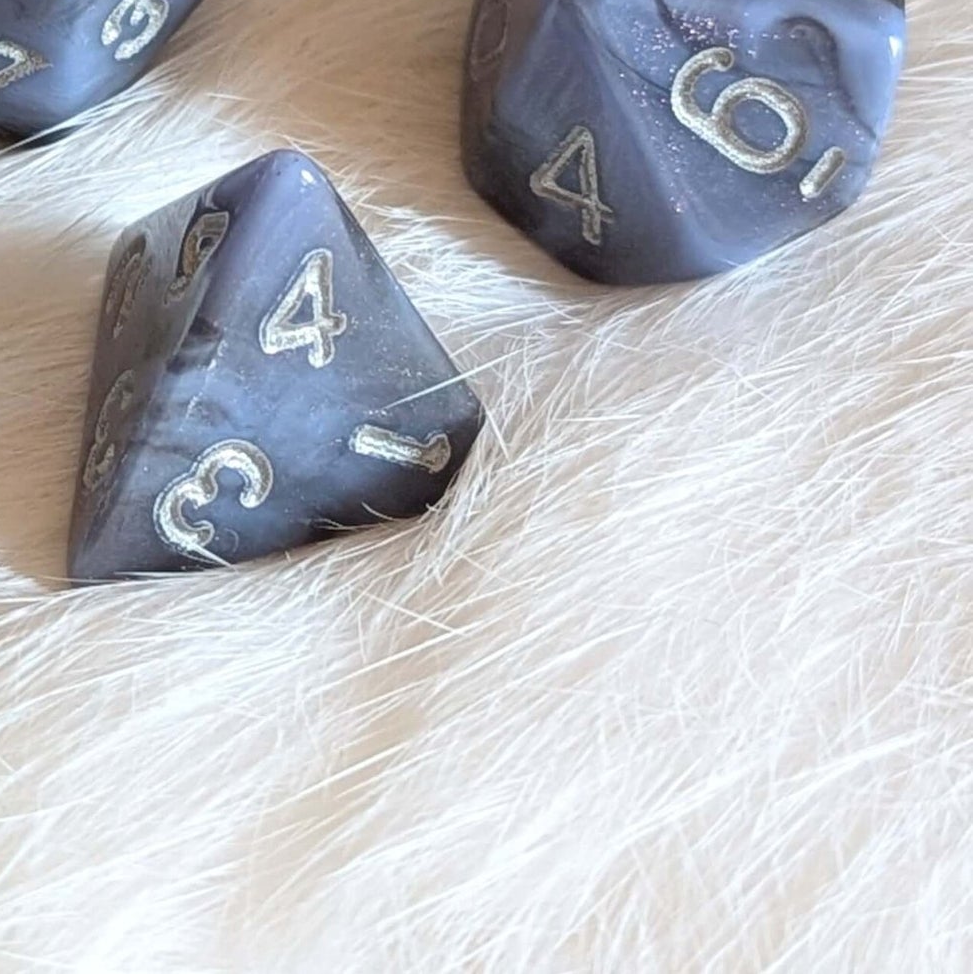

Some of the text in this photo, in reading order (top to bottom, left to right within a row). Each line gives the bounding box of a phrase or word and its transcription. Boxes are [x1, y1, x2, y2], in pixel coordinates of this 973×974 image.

[530, 125, 615, 245] 4
[259, 249, 347, 368] 4
[153, 439, 274, 556] 3
